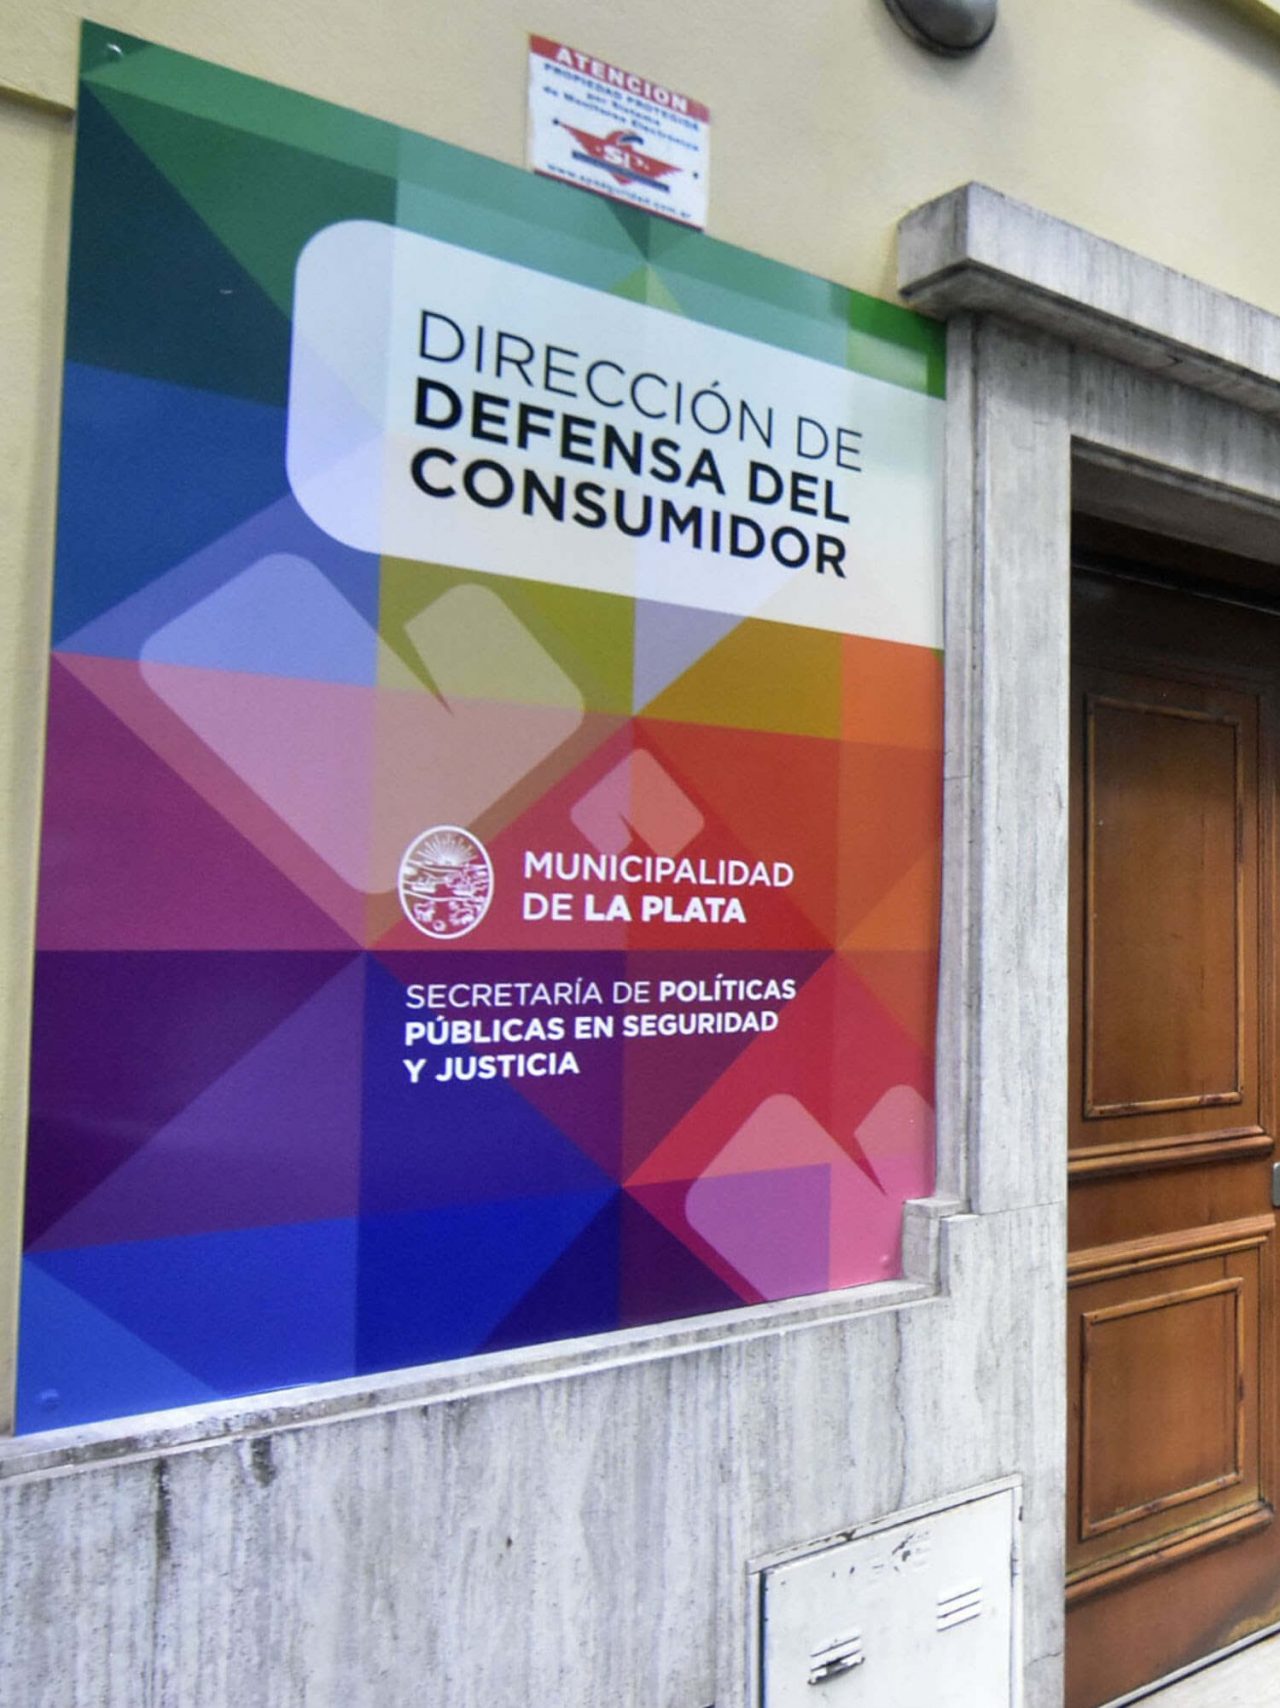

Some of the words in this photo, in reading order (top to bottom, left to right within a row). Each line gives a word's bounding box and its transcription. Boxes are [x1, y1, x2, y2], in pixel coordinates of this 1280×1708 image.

[543, 86, 558, 96] de
[544, 62, 622, 100] PROPIEDAD
[627, 95, 699, 131] PROTEGIDA
[556, 46, 688, 112] ATENCION
[419, 309, 774, 449] DIRECCIÓN
[797, 415, 863, 472] DE
[414, 376, 726, 496] DEFENSA
[748, 459, 851, 524] DEL
[410, 446, 847, 579] CONSUMIDOR
[523, 851, 794, 888] MUNICIPALIDAD
[522, 893, 573, 922] DE
[585, 895, 631, 922] LA
[641, 896, 747, 924] PLATA
[405, 977, 604, 1010] SECRETARÍA
[612, 982, 651, 1004] DE
[659, 974, 797, 1003] POLÍTICAS
[404, 1015, 565, 1047] PÚBLICAS
[574, 1016, 614, 1040] EN
[622, 1011, 779, 1038] SEGURIDAD
[403, 1059, 427, 1083] Y
[435, 1052, 580, 1082] JUSTICIA
